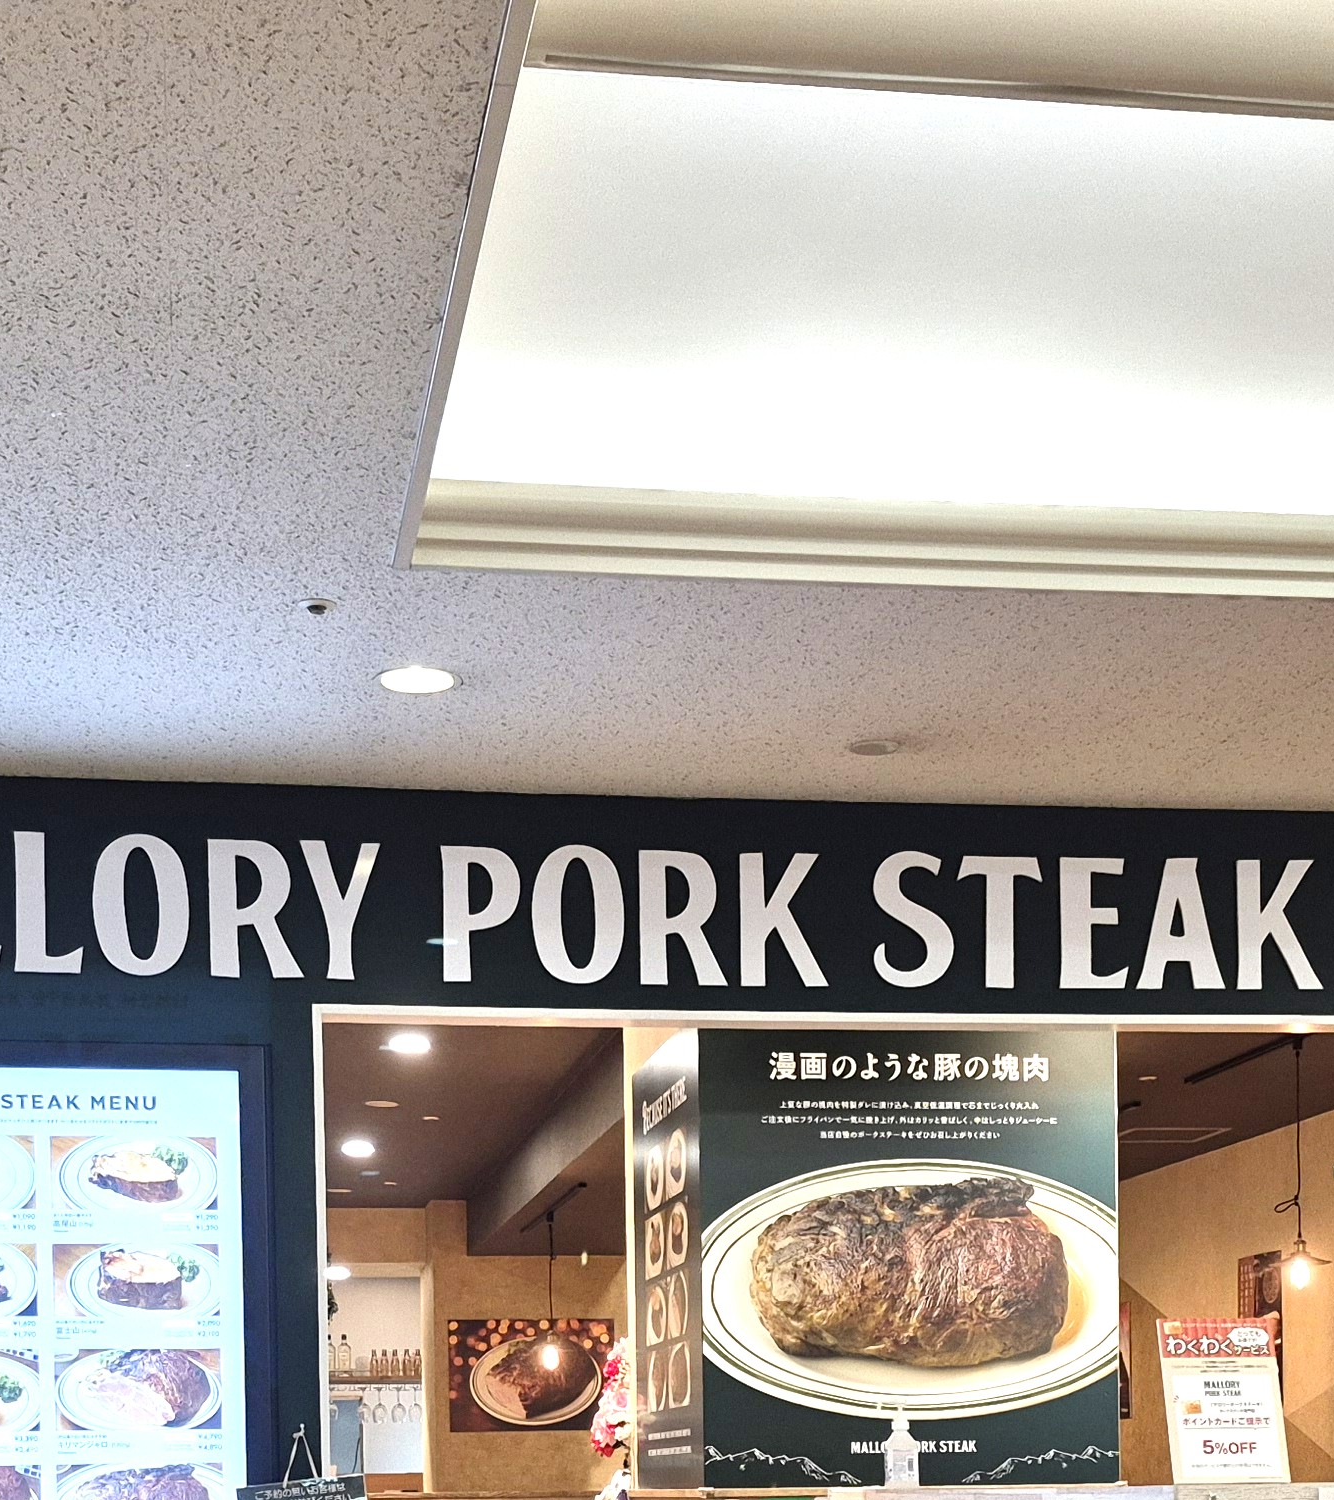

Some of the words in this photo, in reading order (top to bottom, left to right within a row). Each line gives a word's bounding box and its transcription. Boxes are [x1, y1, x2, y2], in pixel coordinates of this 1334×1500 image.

[440, 845, 828, 987] PORK
[874, 851, 1323, 990] STEAK
[769, 1052, 1050, 1082] 漫画のような豚の塊肉
[1, 1094, 82, 1110] STEAK
[91, 1095, 158, 1112] MENU
[1203, 1380, 1240, 1389] MALLORY
[850, 1441, 886, 1454] MALLO
[939, 1440, 977, 1453] STEAK
[1202, 1439, 1257, 1455] 5%OFF
